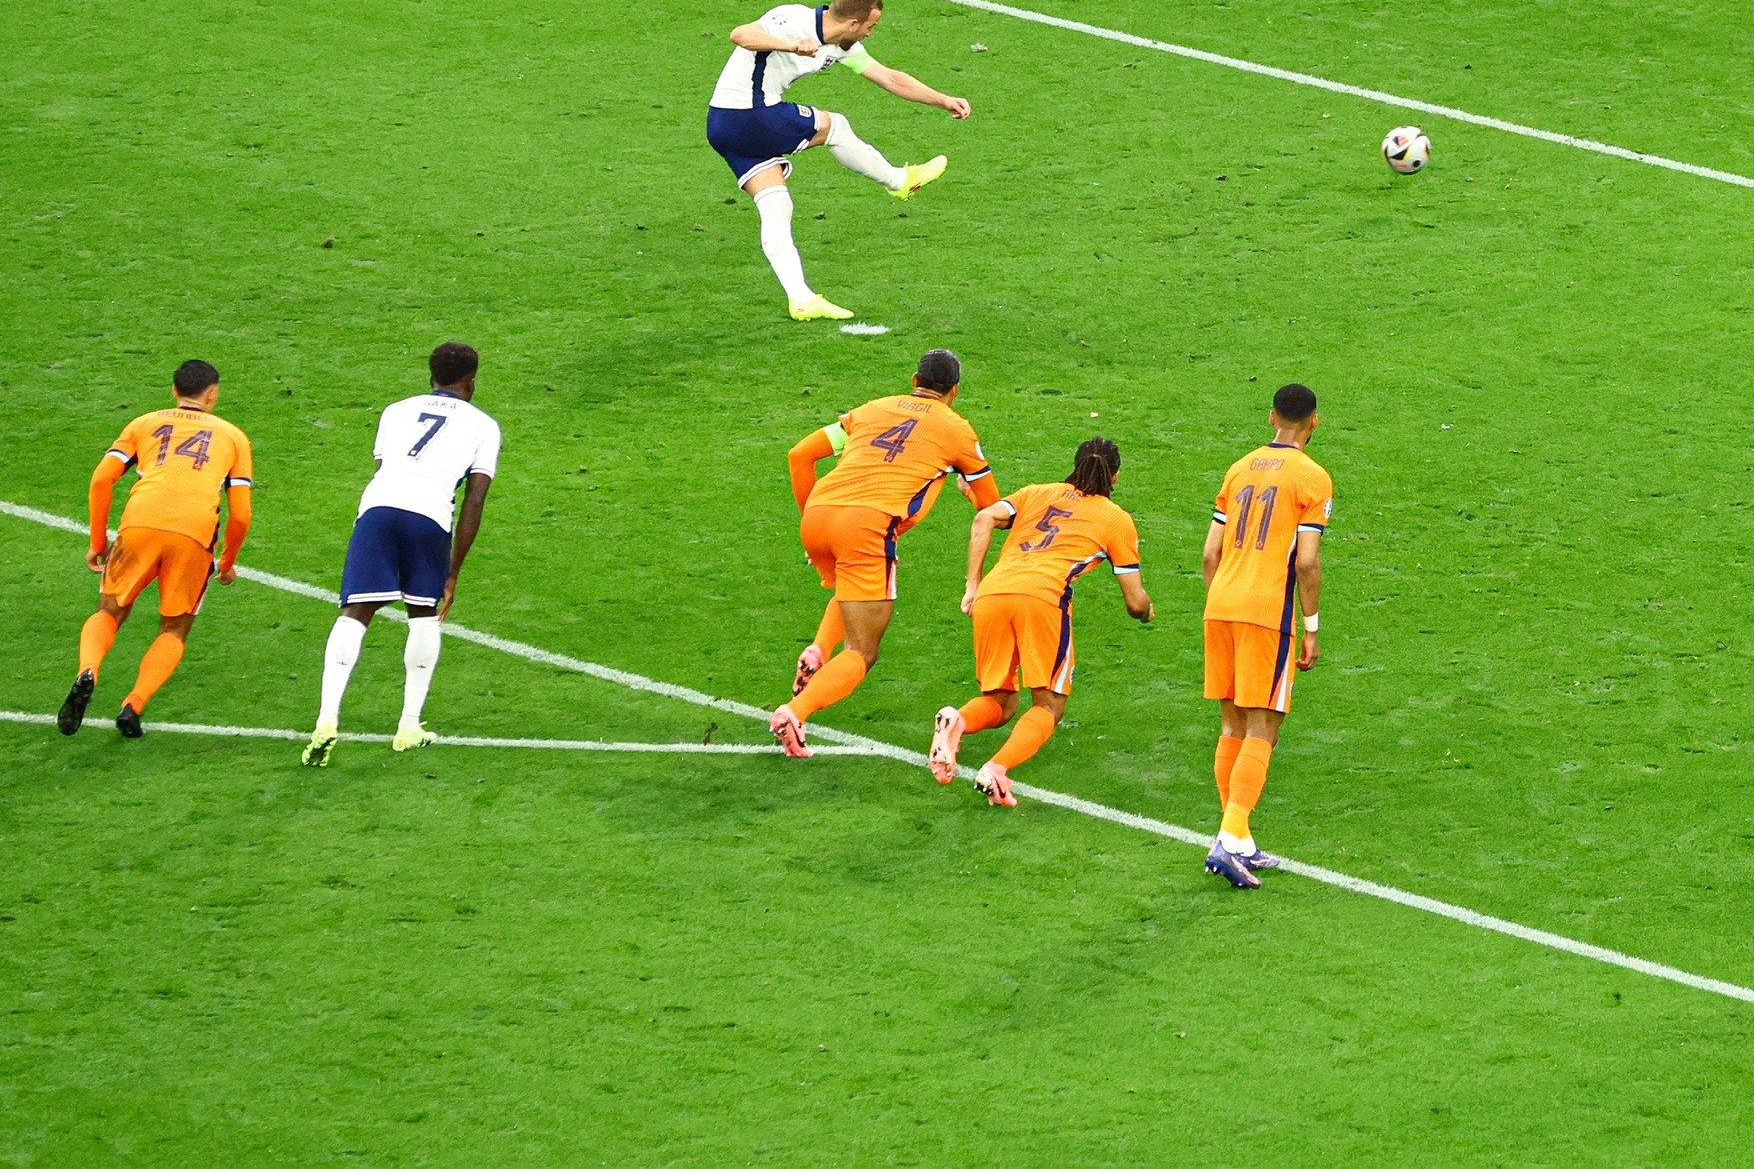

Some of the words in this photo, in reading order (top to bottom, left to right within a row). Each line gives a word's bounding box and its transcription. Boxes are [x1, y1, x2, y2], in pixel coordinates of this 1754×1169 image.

[423, 400, 457, 411] SAKA
[896, 399, 933, 414] VIRGIL
[150, 424, 214, 471] 14
[407, 412, 449, 460] 7
[870, 418, 919, 463] 4
[1250, 457, 1285, 471] GAKPO
[1019, 504, 1074, 553] 5
[1234, 484, 1278, 551] 11
